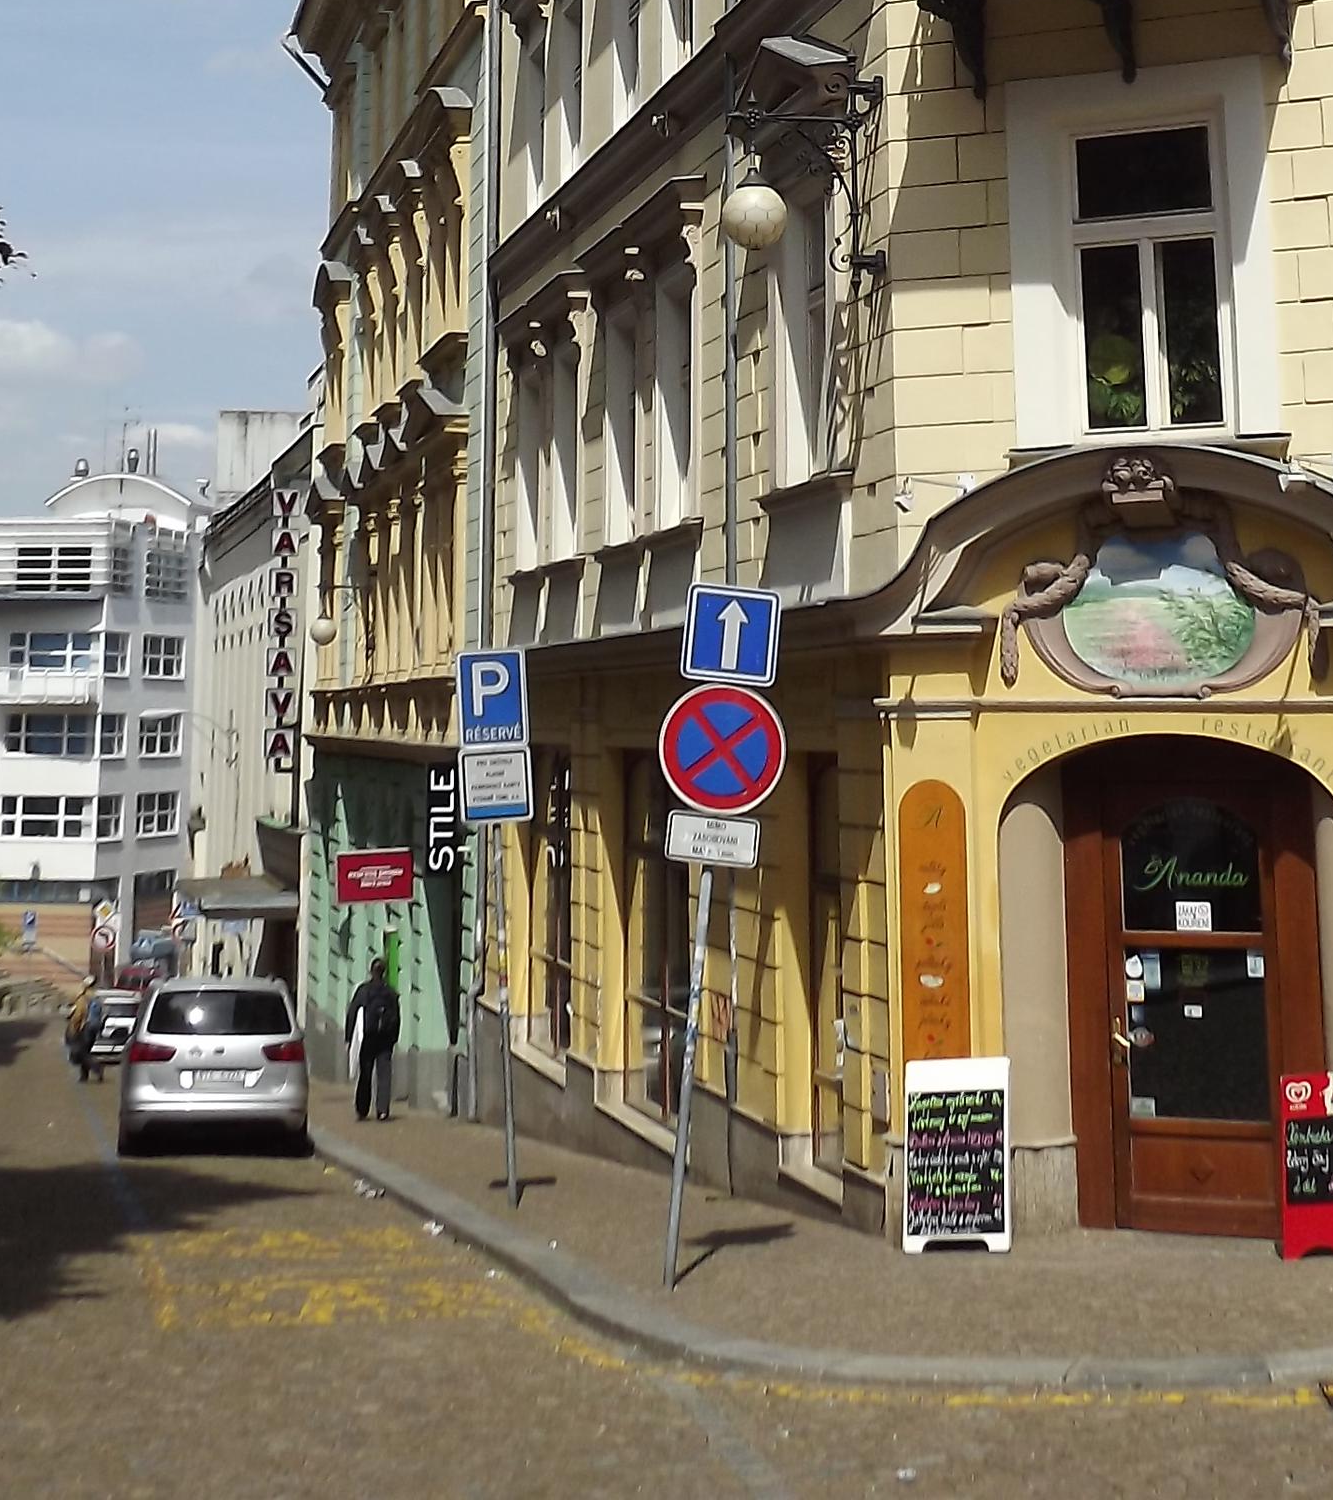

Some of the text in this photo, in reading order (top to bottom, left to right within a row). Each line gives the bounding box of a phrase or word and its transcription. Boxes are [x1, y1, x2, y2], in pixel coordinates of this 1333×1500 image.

[471, 662, 509, 716] P
[465, 722, 521, 742] RÉSERVÉ
[1003, 717, 1131, 783] vegetarian
[429, 767, 455, 871] STILE
[1133, 855, 1249, 891] Ananda
